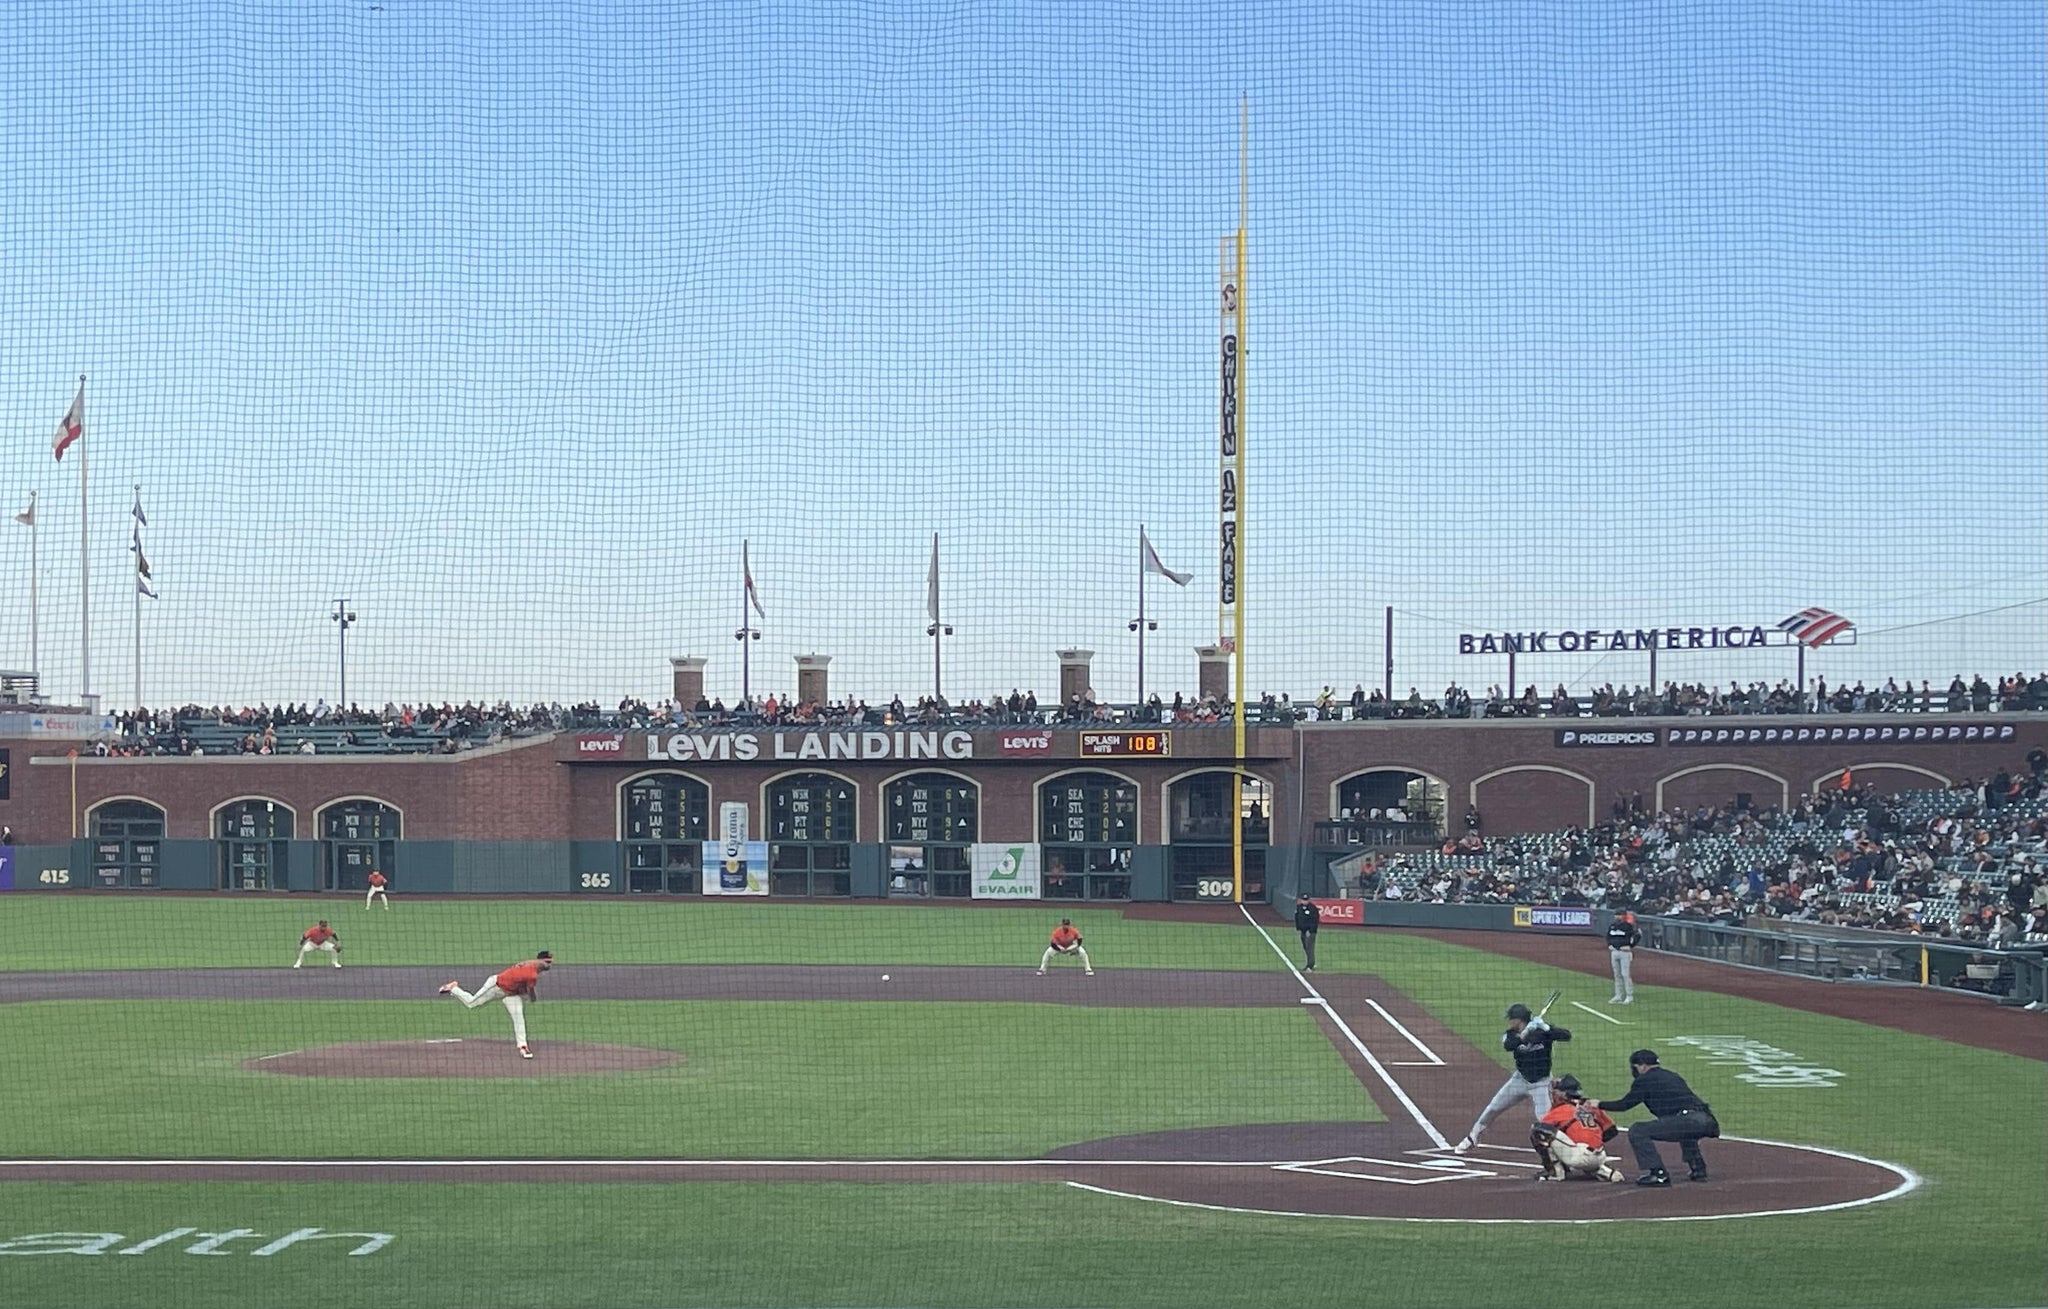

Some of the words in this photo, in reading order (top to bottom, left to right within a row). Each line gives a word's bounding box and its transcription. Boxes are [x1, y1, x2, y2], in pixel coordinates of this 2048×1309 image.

[1223, 337, 1236, 455] CHIKIN
[1223, 472, 1235, 510] IZ
[1223, 523, 1235, 602] FARE
[1459, 632, 1546, 654] BANK
[1558, 630, 1601, 652] OF
[1610, 626, 1768, 650] AMERICA
[1084, 735, 1120, 746] SPLASH
[1128, 736, 1156, 751] 108
[1579, 732, 1655, 744] PRIZEPICKS
[774, 731, 973, 760] LANDING
[912, 789, 928, 800] ATH
[1052, 795, 1058, 807] 7
[1068, 788, 1084, 800] SEA
[825, 801, 832, 812] 5
[912, 801, 927, 813] TEX
[1068, 802, 1083, 813] STL
[1103, 802, 1109, 813] 2
[911, 817, 928, 828] NYY
[727, 811, 738, 857] Corona
[1068, 830, 1084, 841] LAD
[40, 869, 69, 883] 415
[581, 873, 611, 888] 365
[979, 886, 1006, 894] EVA
[1007, 886, 1033, 894] AIR
[1198, 880, 1233, 897] 309
[1315, 904, 1354, 918] RACLE
[1531, 910, 1561, 924] SPORTS
[1561, 911, 1591, 925] LEADER
